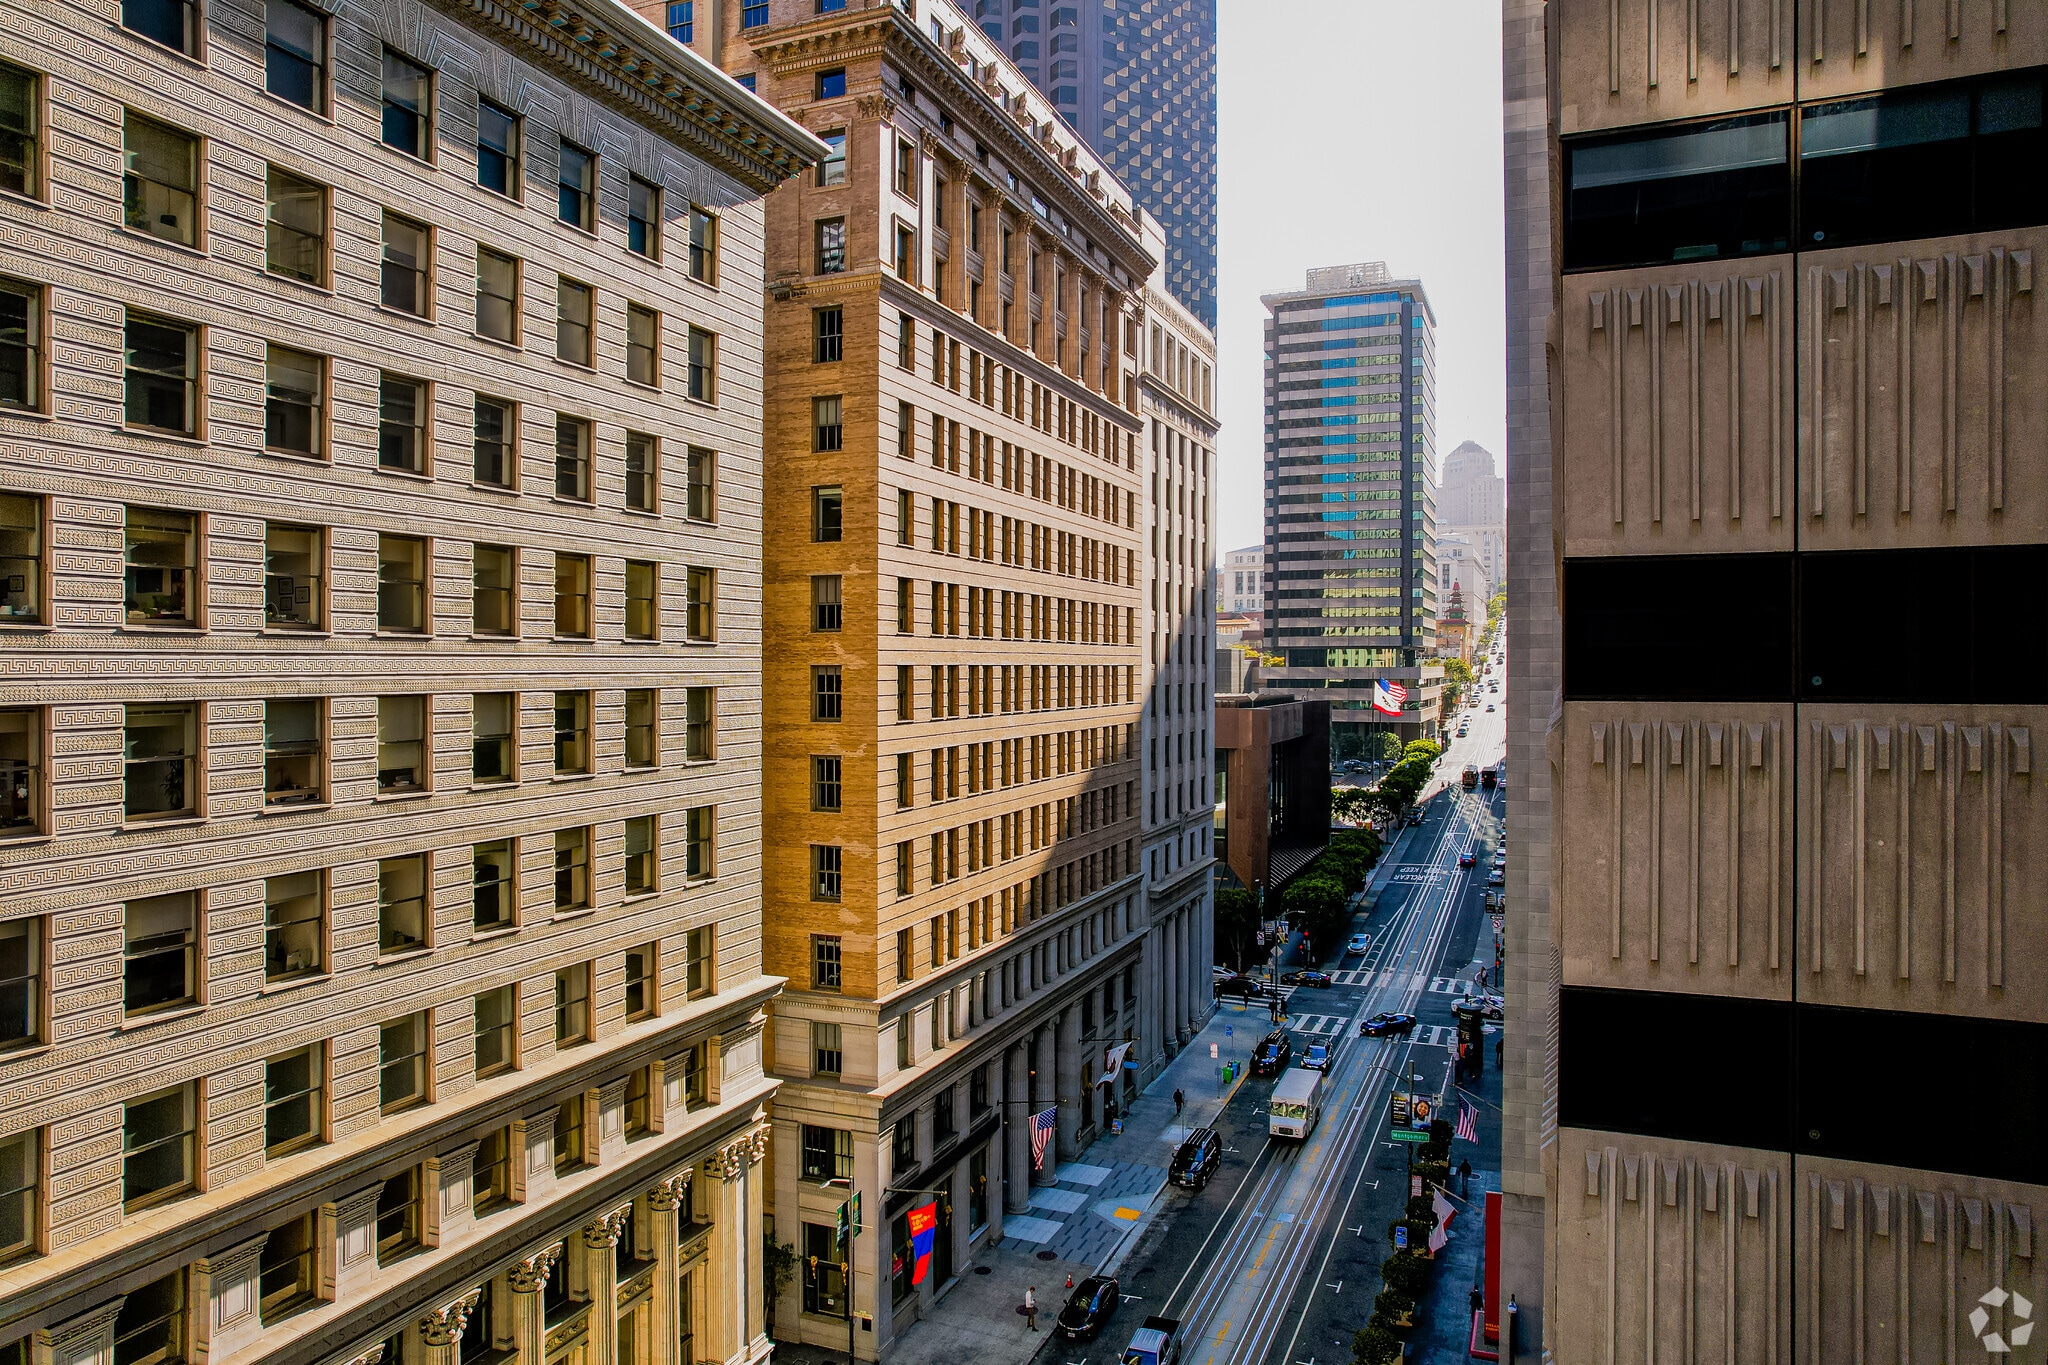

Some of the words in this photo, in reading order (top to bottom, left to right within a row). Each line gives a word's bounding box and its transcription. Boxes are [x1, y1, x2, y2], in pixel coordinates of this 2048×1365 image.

[1392, 1133, 1428, 1141] Montgomery
[310, 1284, 430, 1357] INSURANCE
[458, 1222, 545, 1273] EXCHANGE
